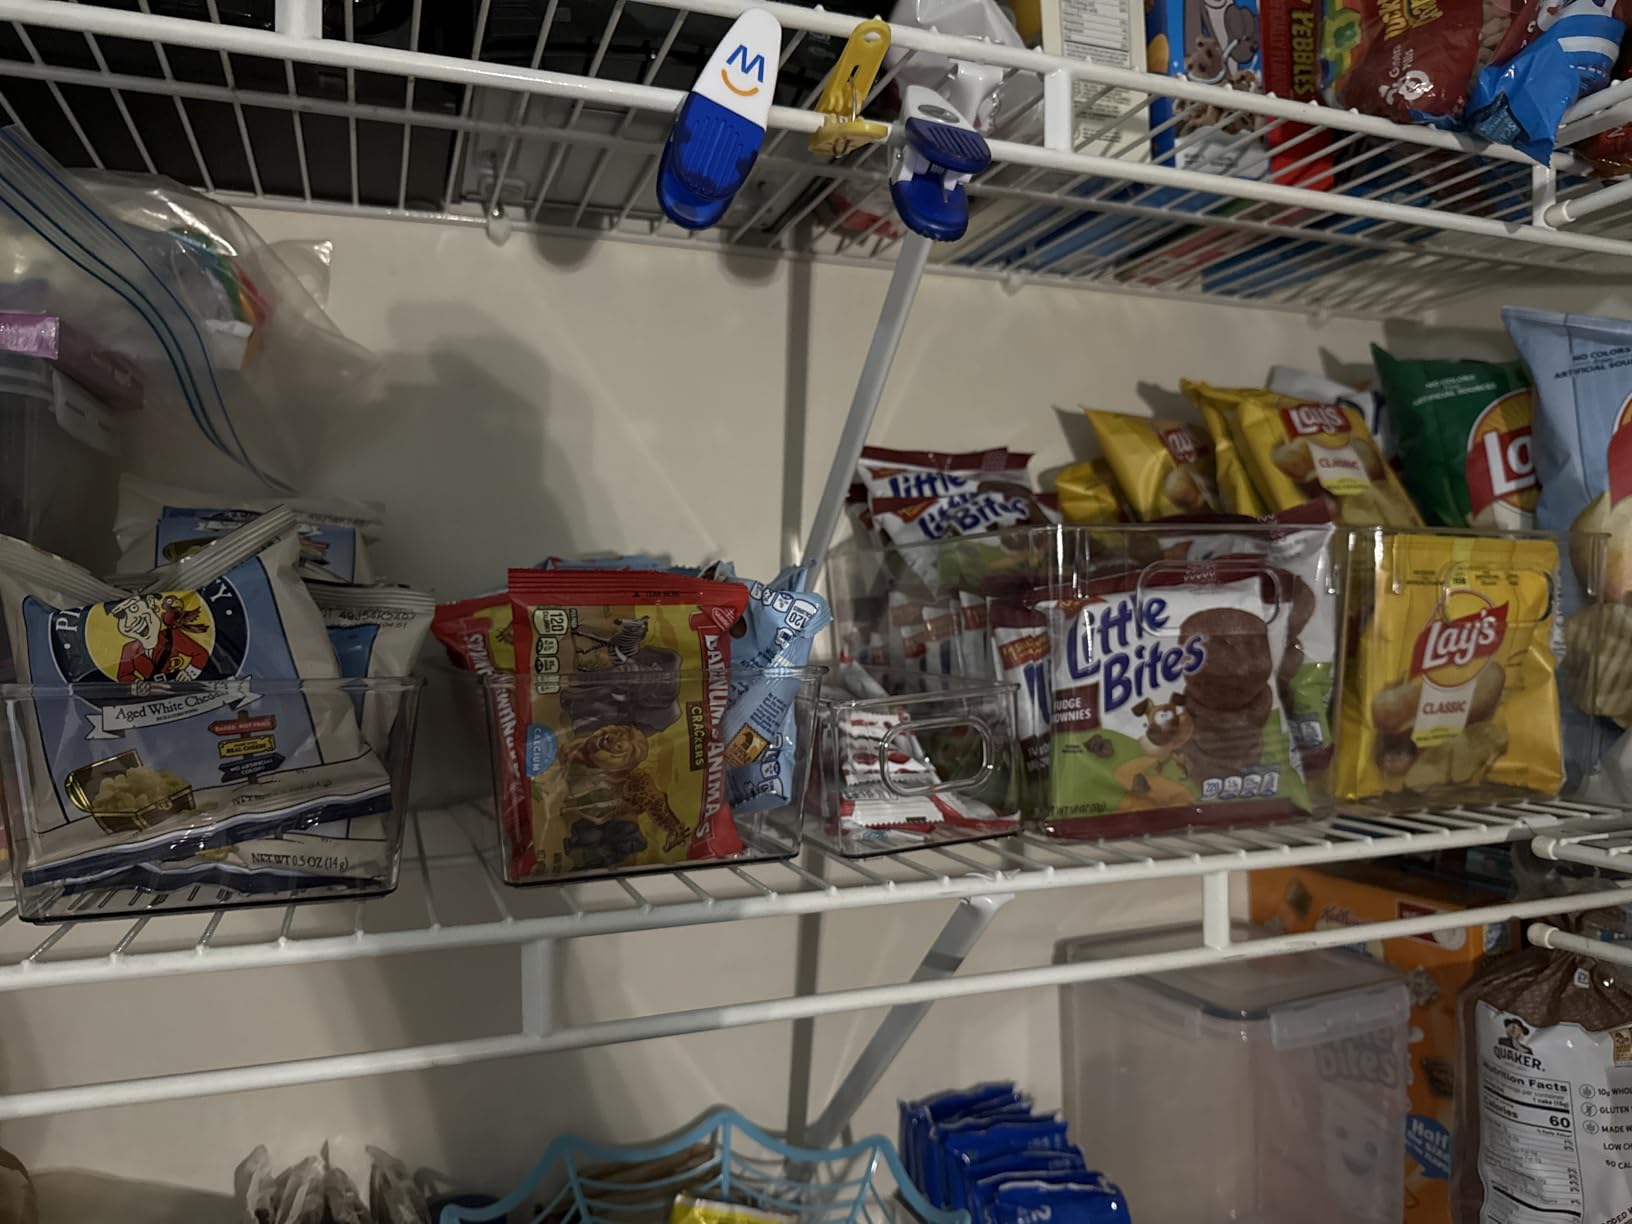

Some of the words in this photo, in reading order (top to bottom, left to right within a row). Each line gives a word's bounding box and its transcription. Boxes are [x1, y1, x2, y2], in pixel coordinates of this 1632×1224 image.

[1291, 9, 1314, 95] PEBBLES
[1590, 347, 1631, 358] COLORS
[1554, 365, 1606, 378] ARTIFICIAL
[1288, 403, 1344, 434] Lay's
[1319, 456, 1360, 471] CLASSIC
[550, 613, 565, 632] 120
[789, 611, 808, 628] 120
[1066, 593, 1170, 681] Little
[1422, 608, 1498, 670] Lay's
[1103, 630, 1206, 713] Bites
[115, 704, 147, 722] Aged
[149, 700, 184, 715] White
[1422, 701, 1467, 715] CLASSIC
[690, 704, 705, 767] CRACKERS
[533, 727, 542, 772] CALCIUM
[695, 742, 725, 839] ANIMAS
[251, 853, 274, 864] NET
[274, 854, 291, 865] WT
[307, 856, 323, 868] OZ
[1528, 1079, 1568, 1093] Facts
[1600, 1106, 1629, 1114] GLUTEN
[1549, 1115, 1571, 1128] 60
[1411, 1118, 1449, 1149] Half
[1603, 1143, 1621, 1151] LOW
